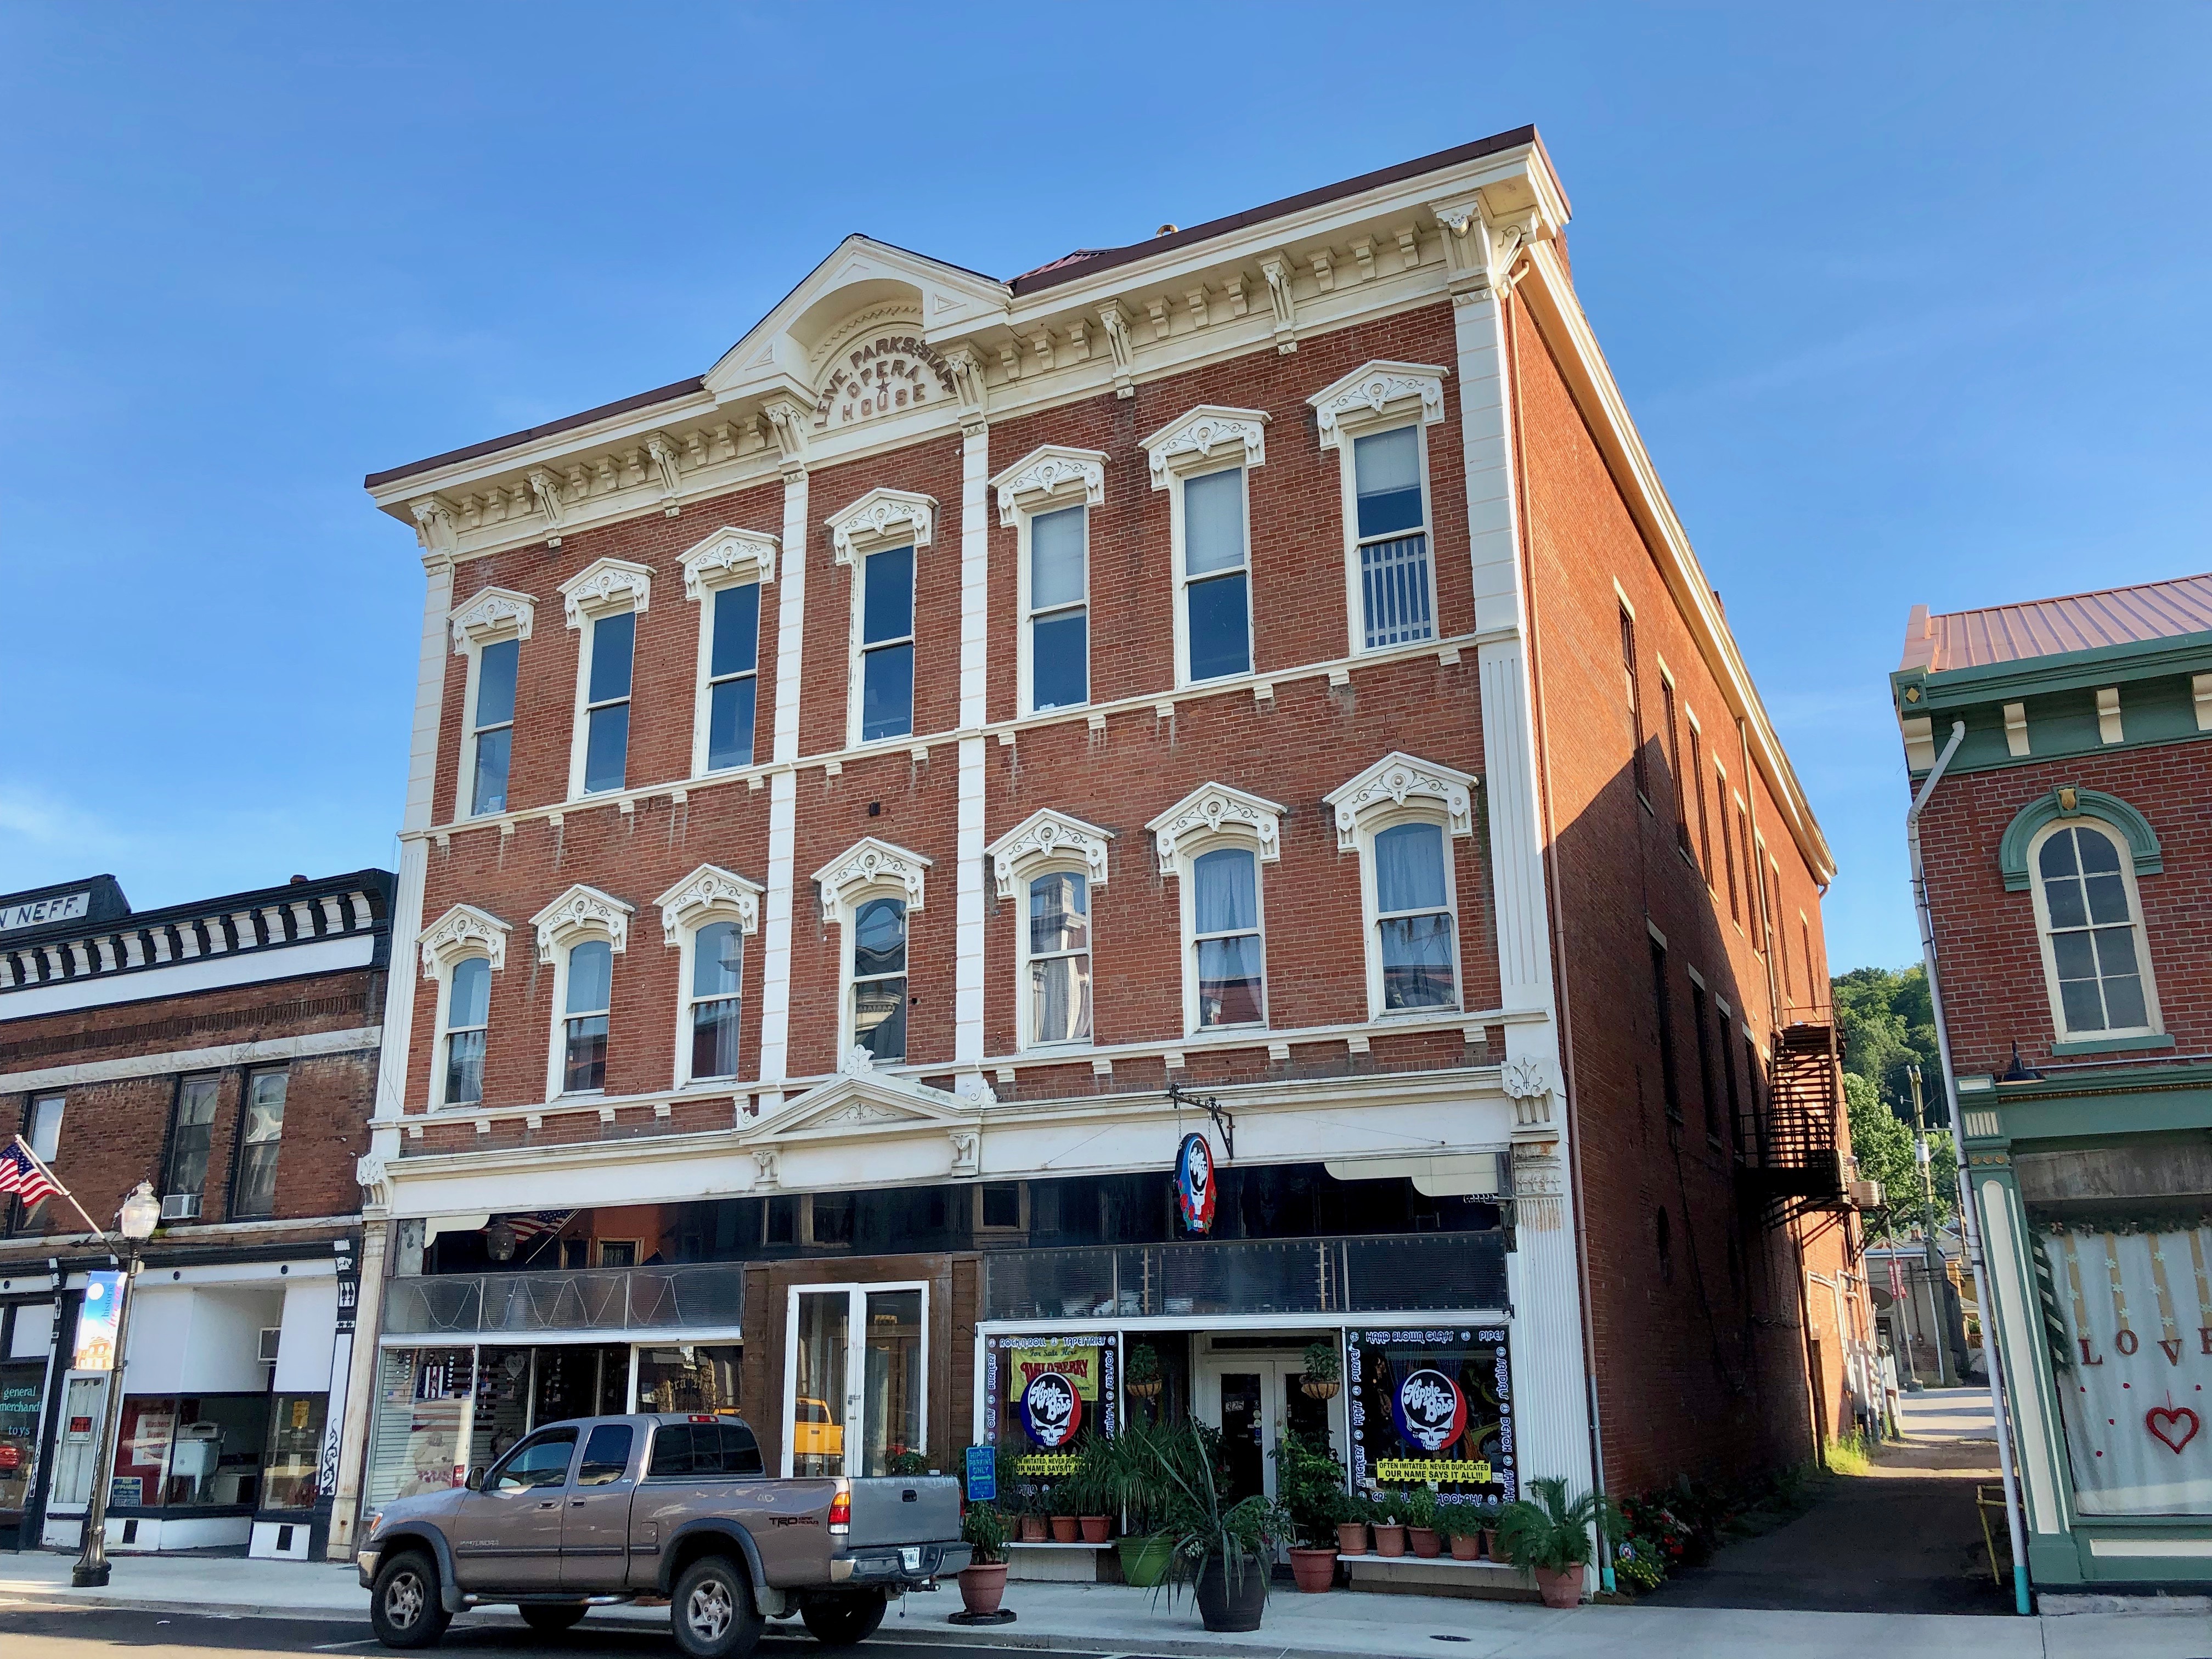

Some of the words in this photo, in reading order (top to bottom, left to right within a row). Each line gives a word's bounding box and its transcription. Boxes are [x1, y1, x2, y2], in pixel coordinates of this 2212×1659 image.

[850, 336, 916, 369] PARKS
[847, 359, 920, 399] OPERA
[843, 383, 926, 421] HOUSE
[16, 896, 80, 924] NEFF.
[1063, 1336, 1106, 1348] TAPESTRIES
[1365, 1331, 1390, 1344] HAND
[1392, 1331, 1425, 1344] BLOWN
[1425, 1331, 1454, 1342] GLASS
[1479, 1330, 1505, 1342] PIPES
[1060, 1347, 1077, 1356] Here
[988, 1353, 997, 1390] BURNERS
[1105, 1350, 1114, 1390] POSTERS
[1351, 1348, 1362, 1383] PURSES
[1495, 1358, 1509, 1400] SANDALS
[3, 1385, 36, 1400] general
[1030, 1381, 1070, 1409] Hippie
[1403, 1379, 1452, 1409] Hippie
[0, 1401, 42, 1412] merchandi
[988, 1408, 996, 1428] OILS
[1046, 1397, 1071, 1421] Bobs
[1226, 1401, 1244, 1412] 325
[1353, 1400, 1365, 1426] HATS
[1424, 1397, 1454, 1422] Bobs
[8, 1425, 30, 1437] toys
[1500, 1417, 1513, 1452] DETOX
[969, 1459, 992, 1467] PARKING
[970, 1451, 990, 1459] HIPPIE
[1355, 1444, 1367, 1488] STICKERS
[1461, 1471, 1483, 1480] ALL!!!
[769, 1517, 797, 1528] TRD
